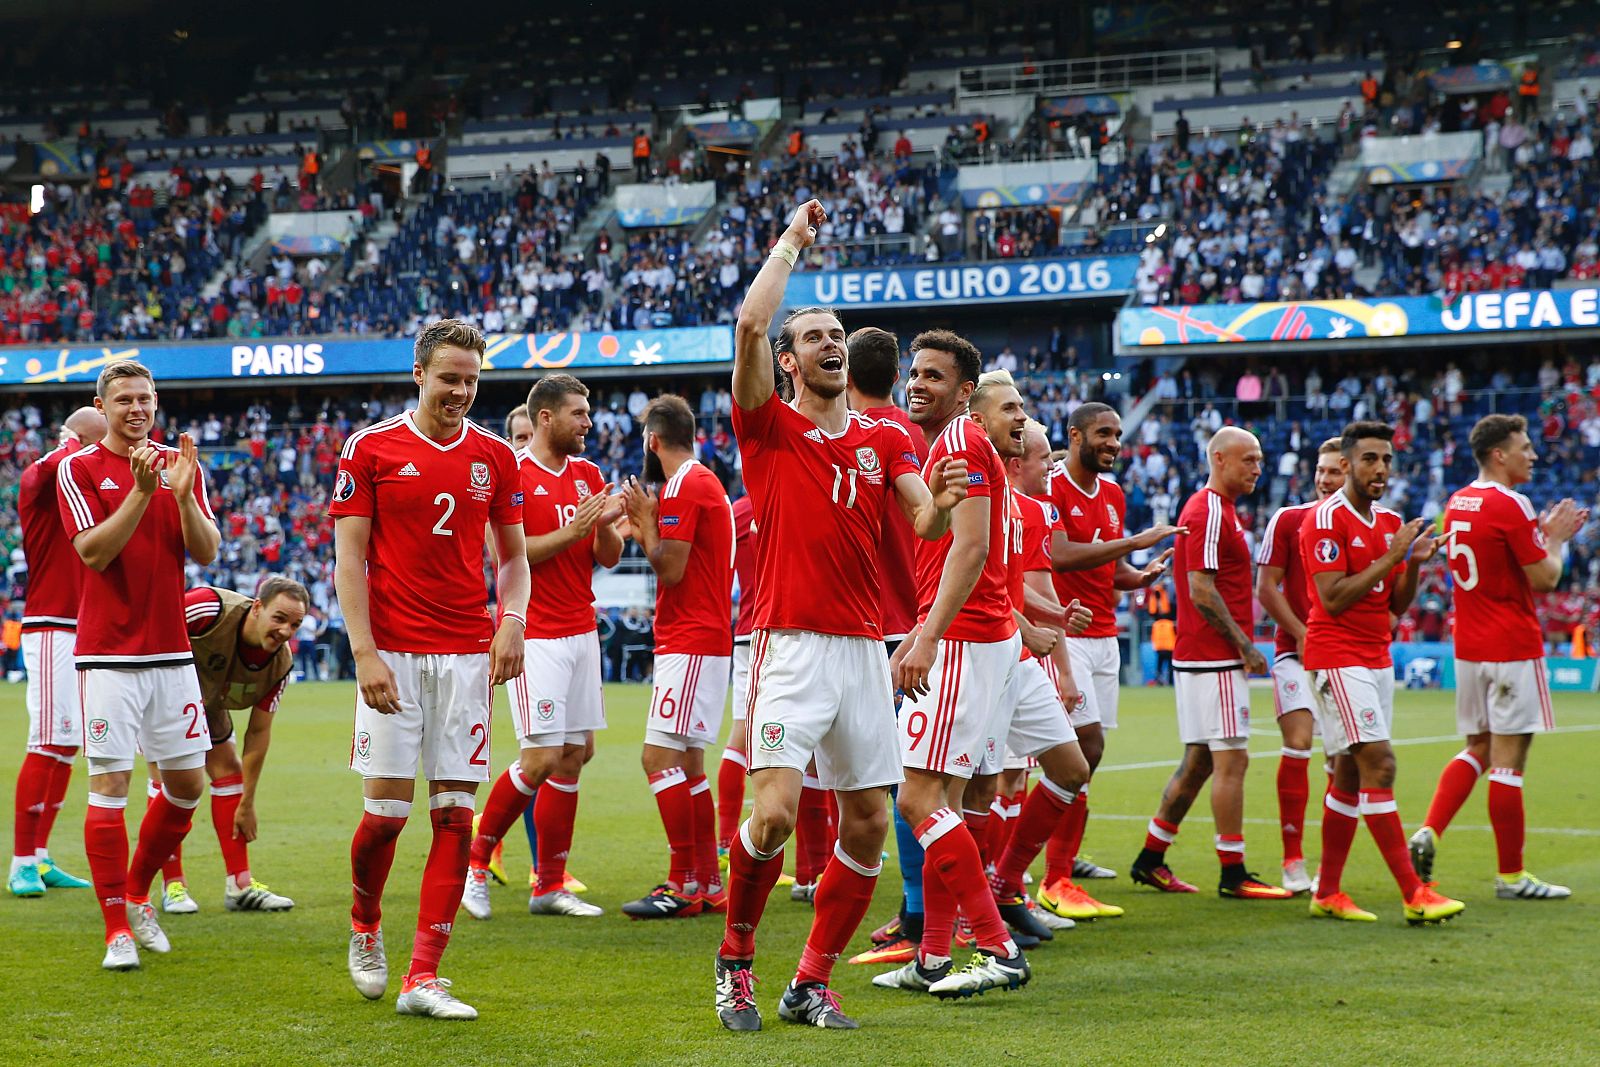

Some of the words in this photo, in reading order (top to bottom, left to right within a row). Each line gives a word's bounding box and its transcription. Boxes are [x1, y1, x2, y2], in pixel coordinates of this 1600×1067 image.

[815, 273, 907, 304] UEFA
[914, 266, 1011, 300] EURO
[1019, 260, 1111, 294] 2016
[1441, 290, 1563, 331] UEFA
[231, 344, 325, 376] PARIS
[803, 431, 825, 445] adidas
[831, 463, 858, 509] 11
[432, 492, 456, 536] 2
[554, 504, 578, 529] 18
[723, 494, 737, 569] 1
[1011, 517, 1024, 555] 10
[1448, 521, 1480, 592] 5
[651, 686, 676, 719] 16
[469, 723, 487, 765] 2
[907, 711, 928, 751] 9
